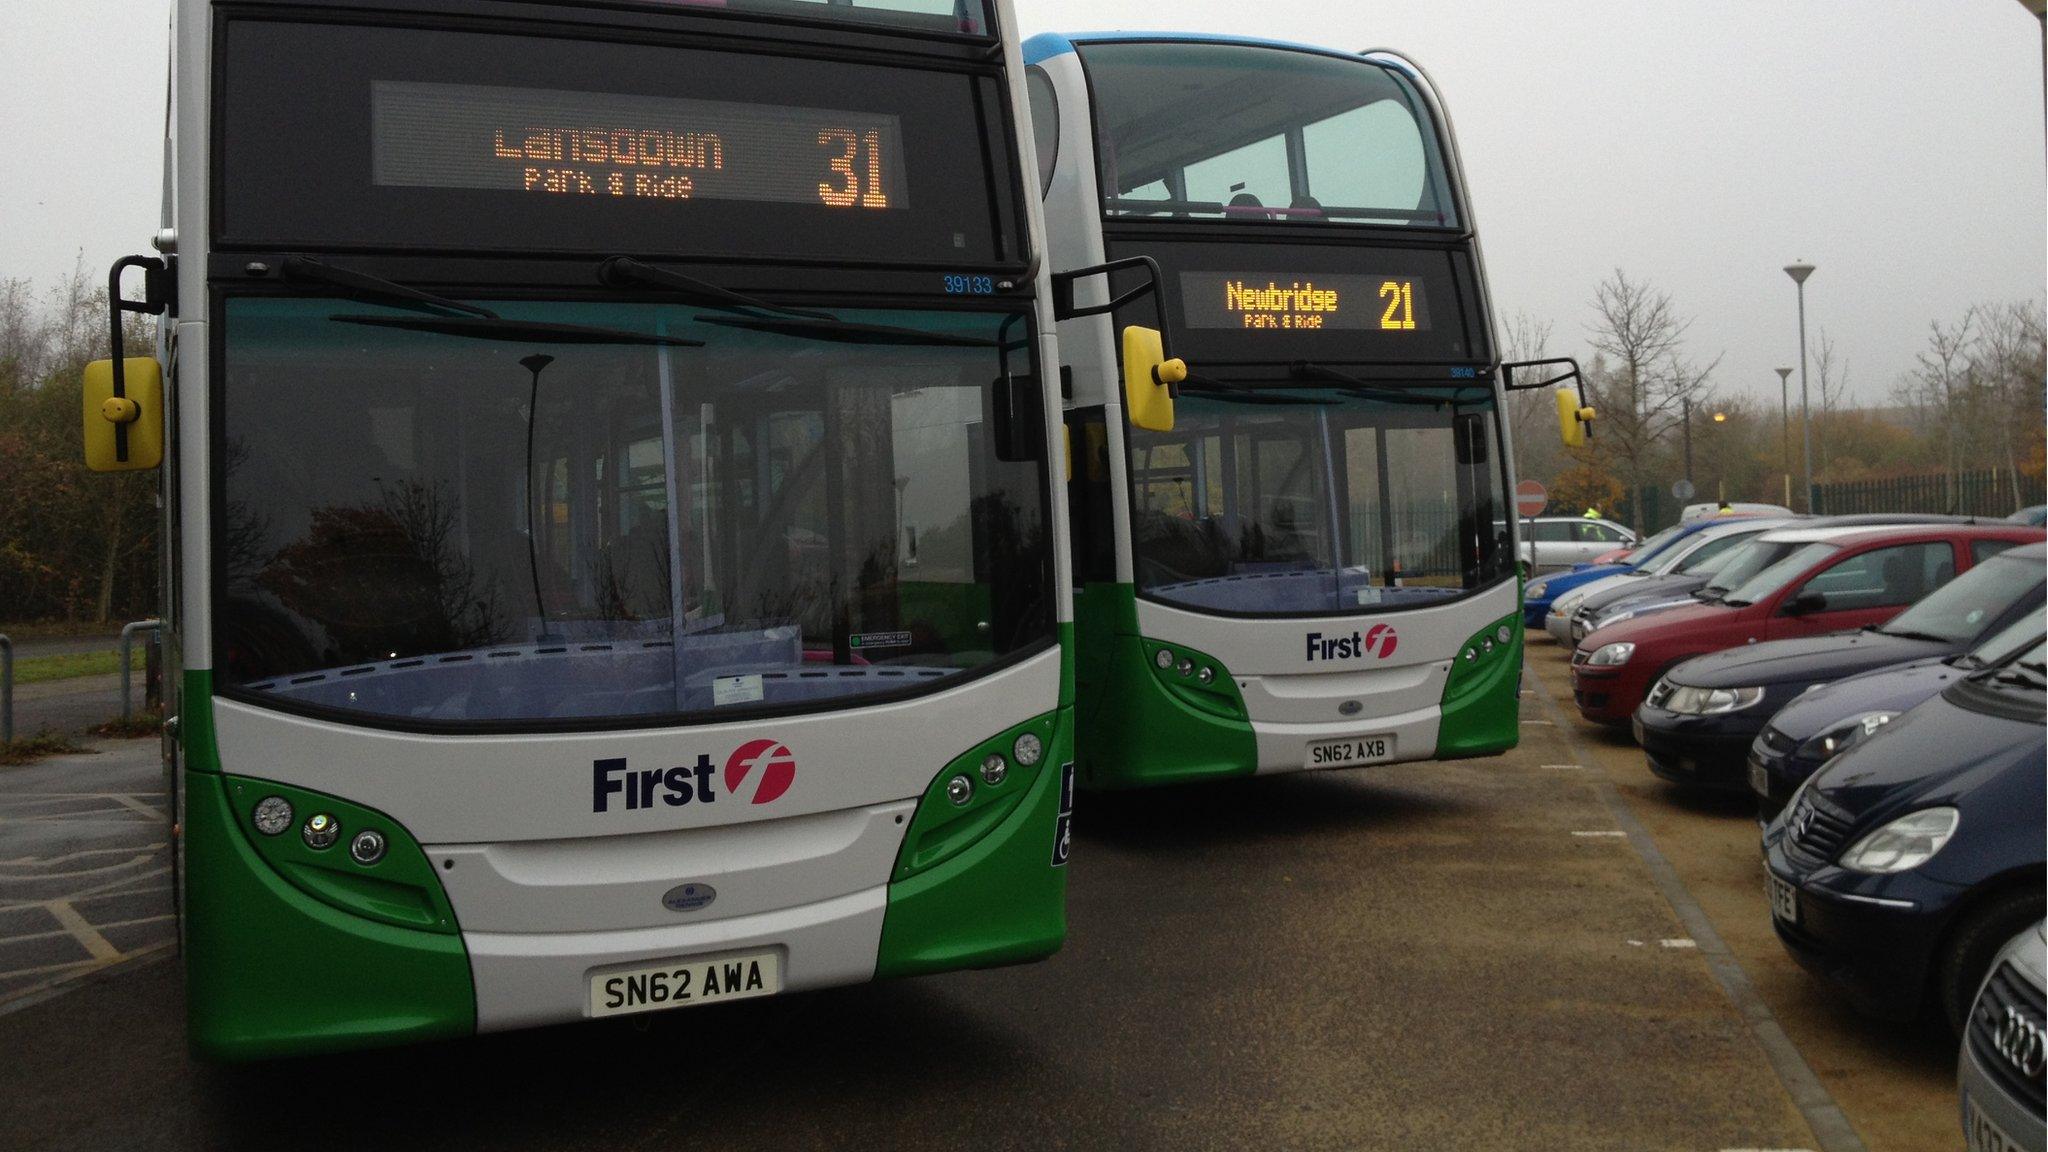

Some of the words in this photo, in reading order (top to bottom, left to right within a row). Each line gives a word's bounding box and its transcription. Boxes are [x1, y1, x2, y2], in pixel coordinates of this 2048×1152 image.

[524, 167, 596, 194] Park
[636, 173, 693, 199] Ride
[818, 127, 887, 208] 31
[943, 275, 992, 294] 39133
[1226, 281, 1338, 312] Newbridge
[1244, 313, 1279, 329] Park
[1295, 314, 1324, 329] Ride
[1378, 281, 1416, 330] 21
[1306, 631, 1362, 662] First
[1312, 743, 1352, 764] SN62
[1356, 740, 1386, 759] AXB
[592, 753, 716, 813] First
[604, 968, 692, 1009] SN62
[702, 960, 764, 997] AWA
